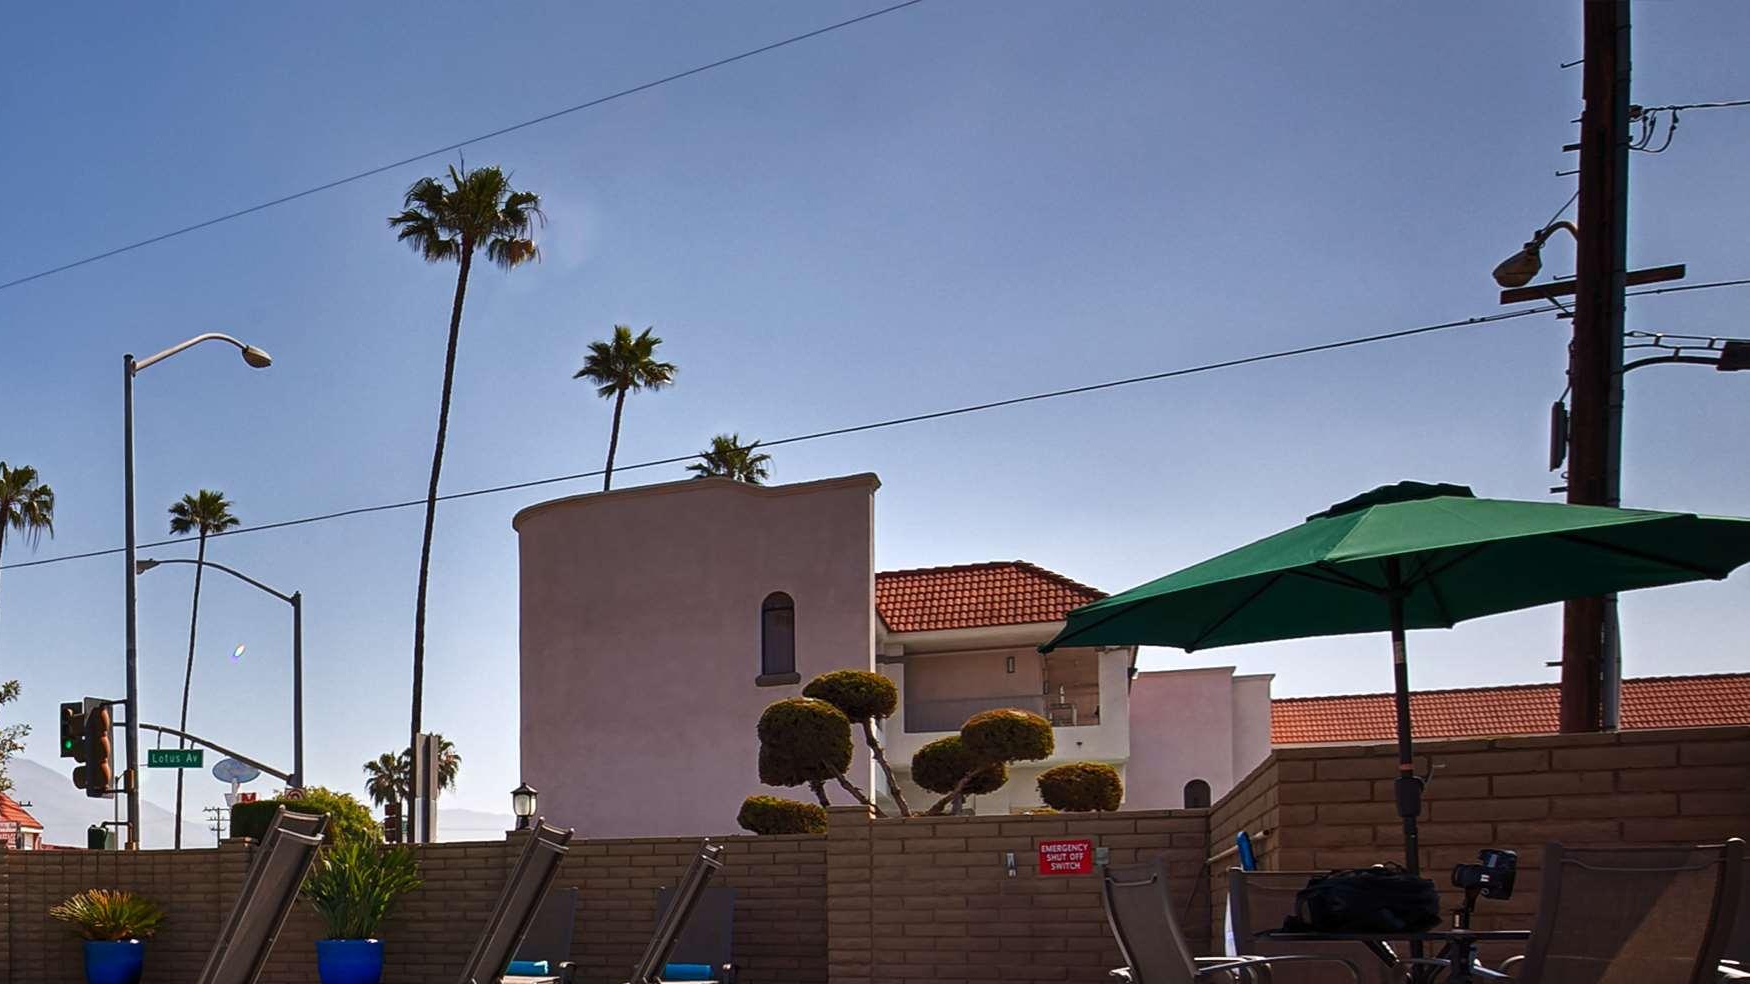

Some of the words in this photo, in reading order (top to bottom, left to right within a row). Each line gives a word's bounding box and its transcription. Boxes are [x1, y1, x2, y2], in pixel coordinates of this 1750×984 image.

[152, 754, 181, 764] Lotus
[185, 753, 198, 762] Av
[1041, 843, 1088, 853] EMERGENCY
[1046, 853, 1066, 862] SHUT
[1069, 852, 1084, 861] OFF
[1050, 862, 1081, 871] SWITCH
